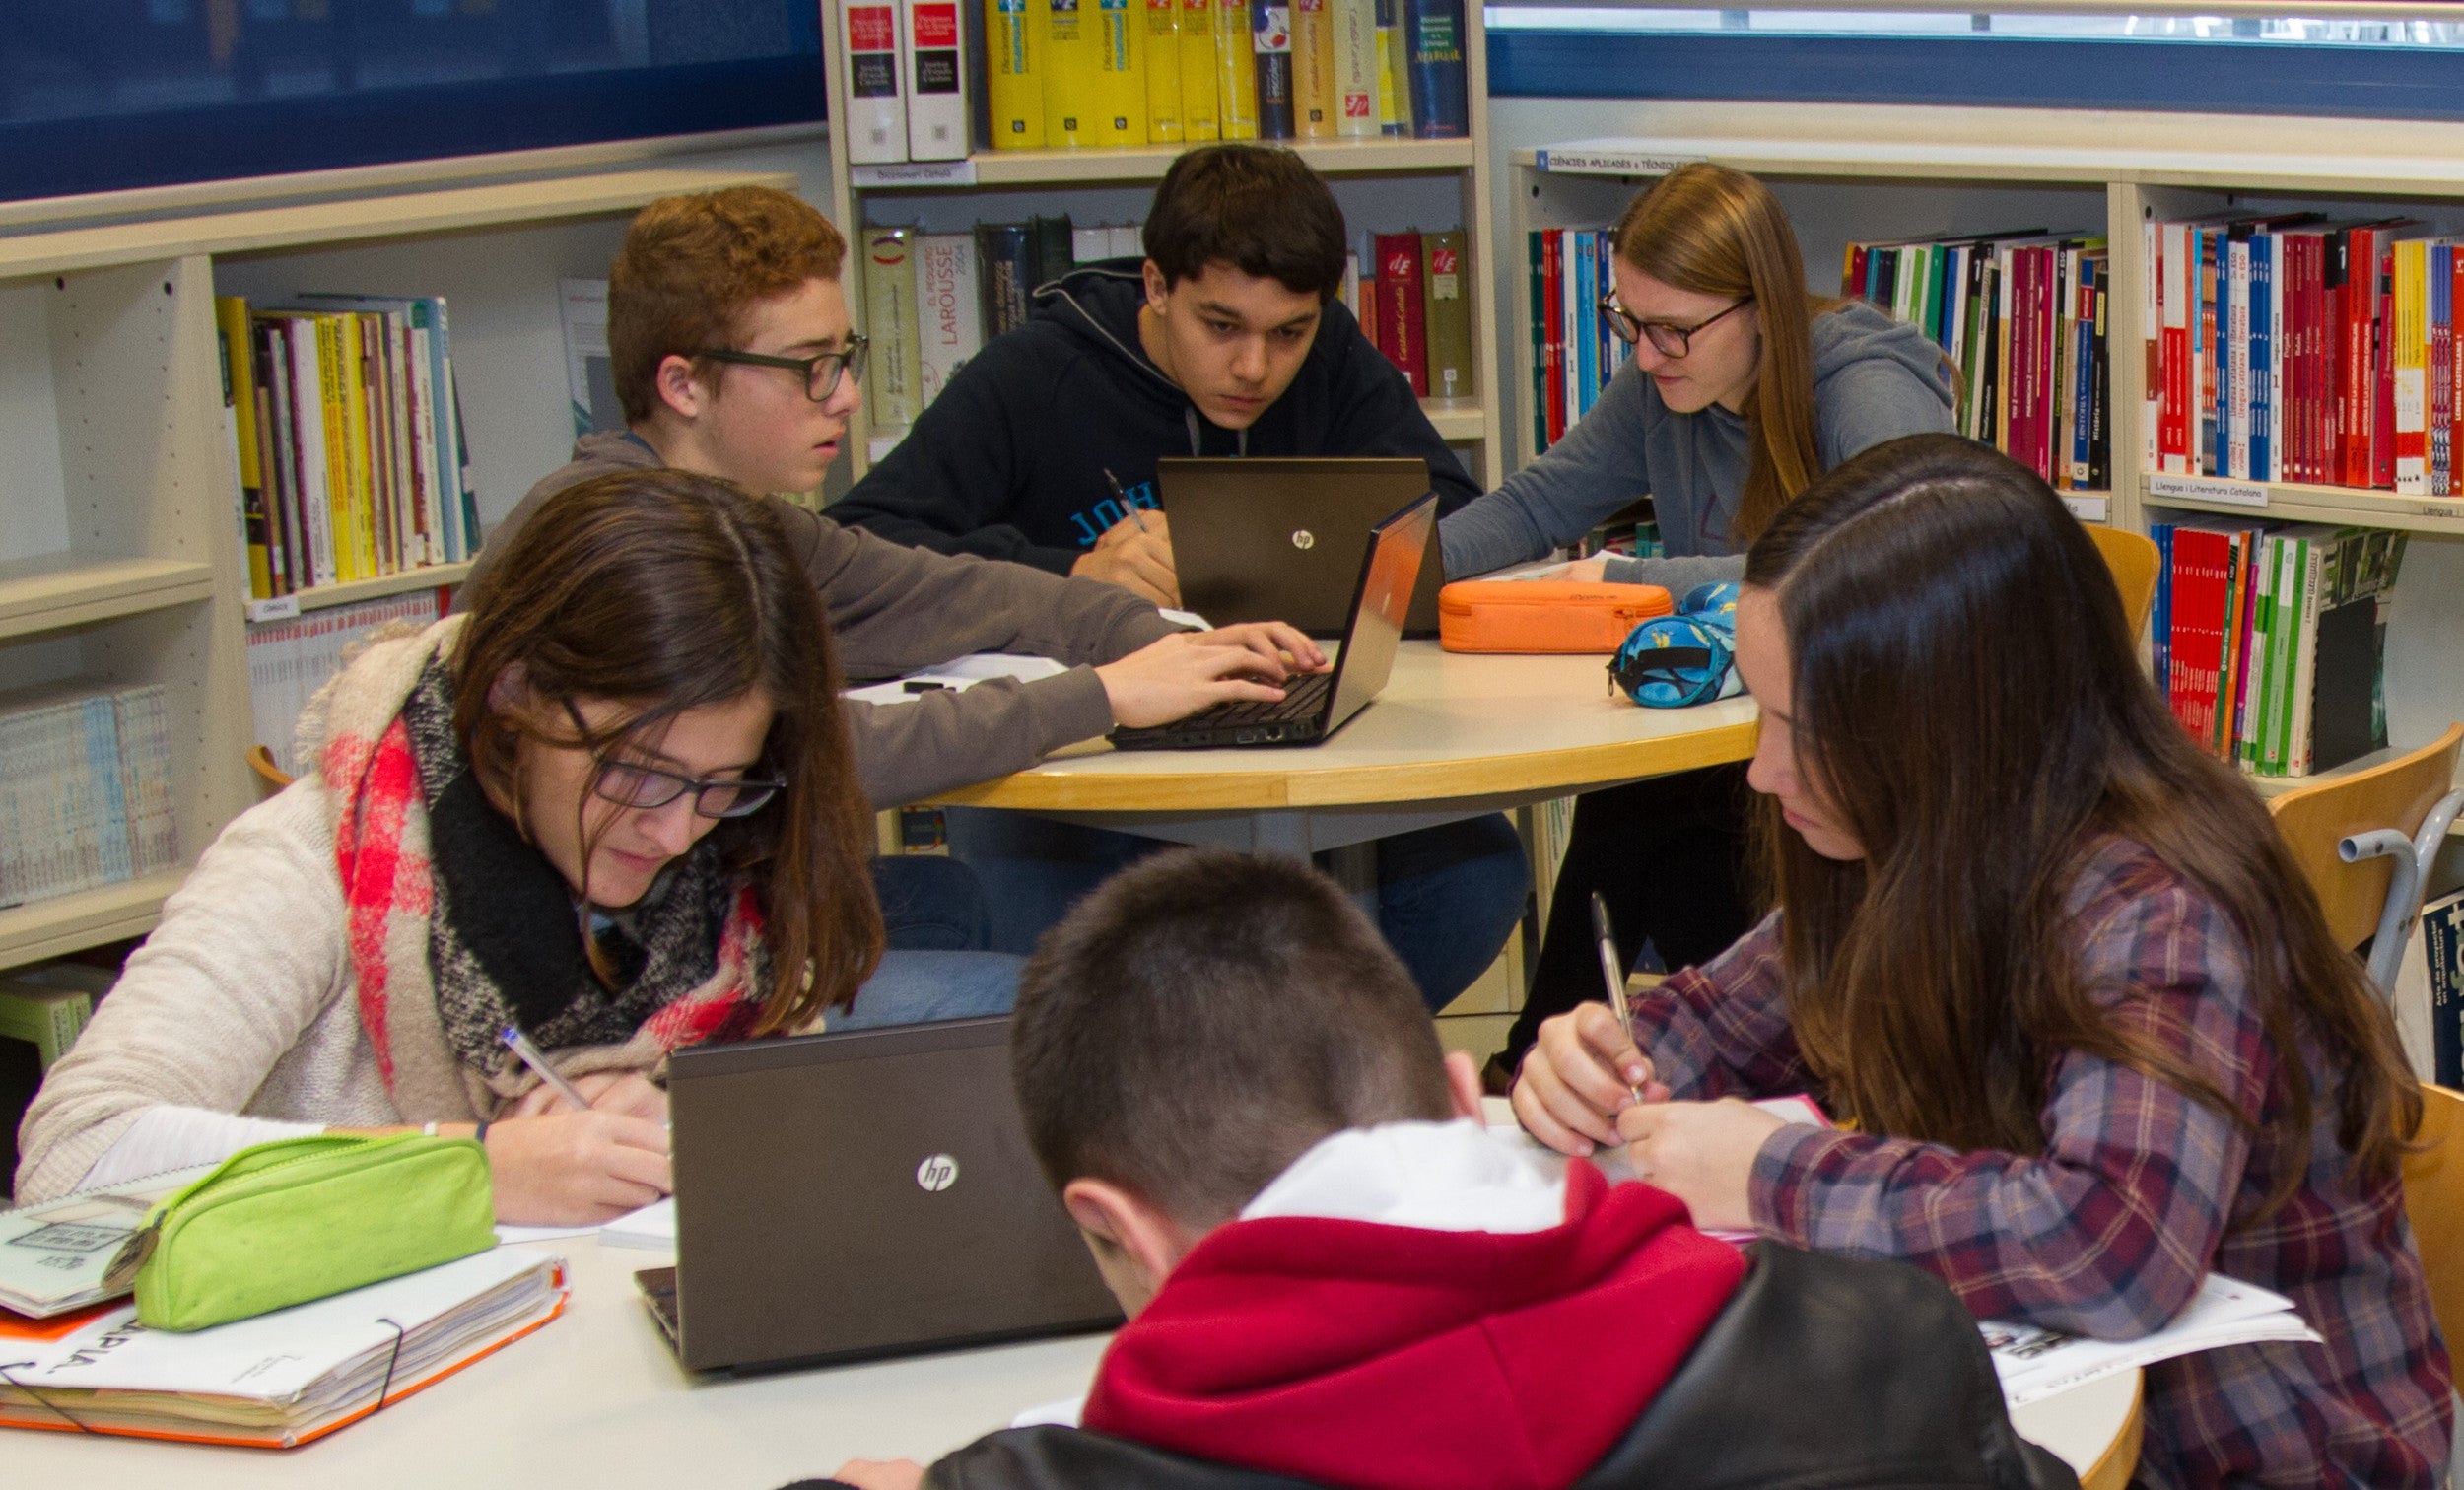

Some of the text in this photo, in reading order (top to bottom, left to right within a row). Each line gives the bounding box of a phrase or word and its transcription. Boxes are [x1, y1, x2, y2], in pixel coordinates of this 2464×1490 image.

[2339, 244, 2347, 269] 1
[936, 246, 958, 345] LAROUSSE
[2454, 341, 2463, 388] CASTELLANA
[2156, 482, 2183, 494] Llengua
[2190, 485, 2227, 495] Literatura
[2230, 488, 2262, 497] Catalana
[2431, 920, 2440, 968] proyectar
[2438, 928, 2447, 989] arquitectura
[2435, 970, 2441, 983] de
[919, 1153, 958, 1191] hp
